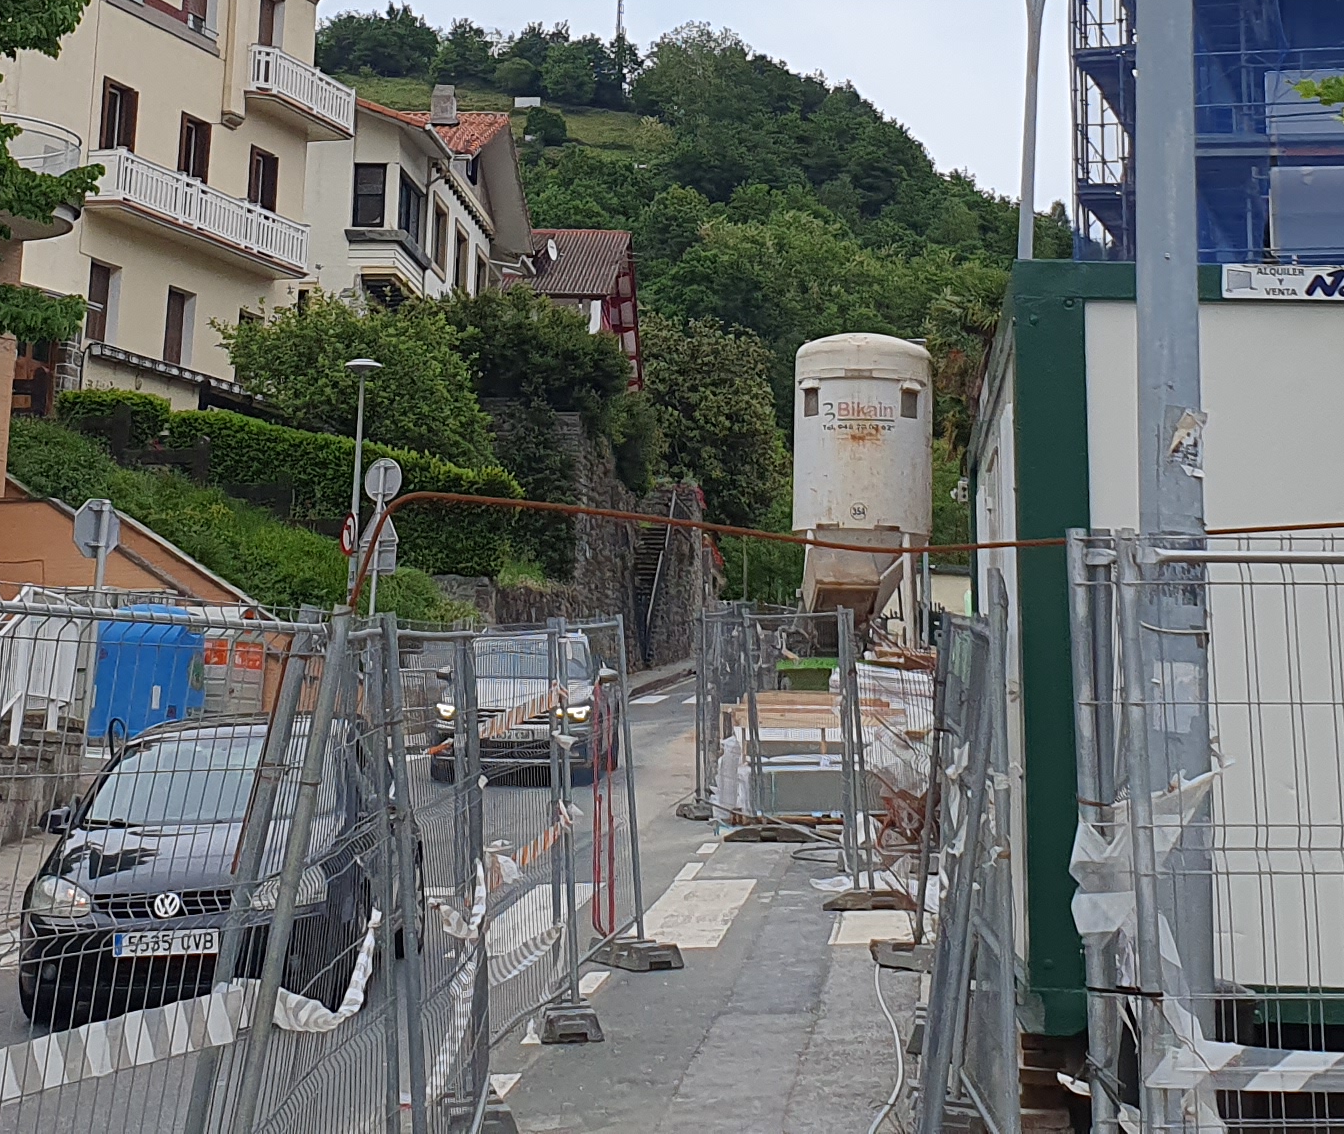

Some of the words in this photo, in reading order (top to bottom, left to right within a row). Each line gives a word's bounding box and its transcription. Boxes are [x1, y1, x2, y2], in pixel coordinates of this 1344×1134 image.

[1256, 267, 1305, 277] ALQUILER
[1277, 277, 1285, 286] Y
[1264, 287, 1298, 296] VENTA
